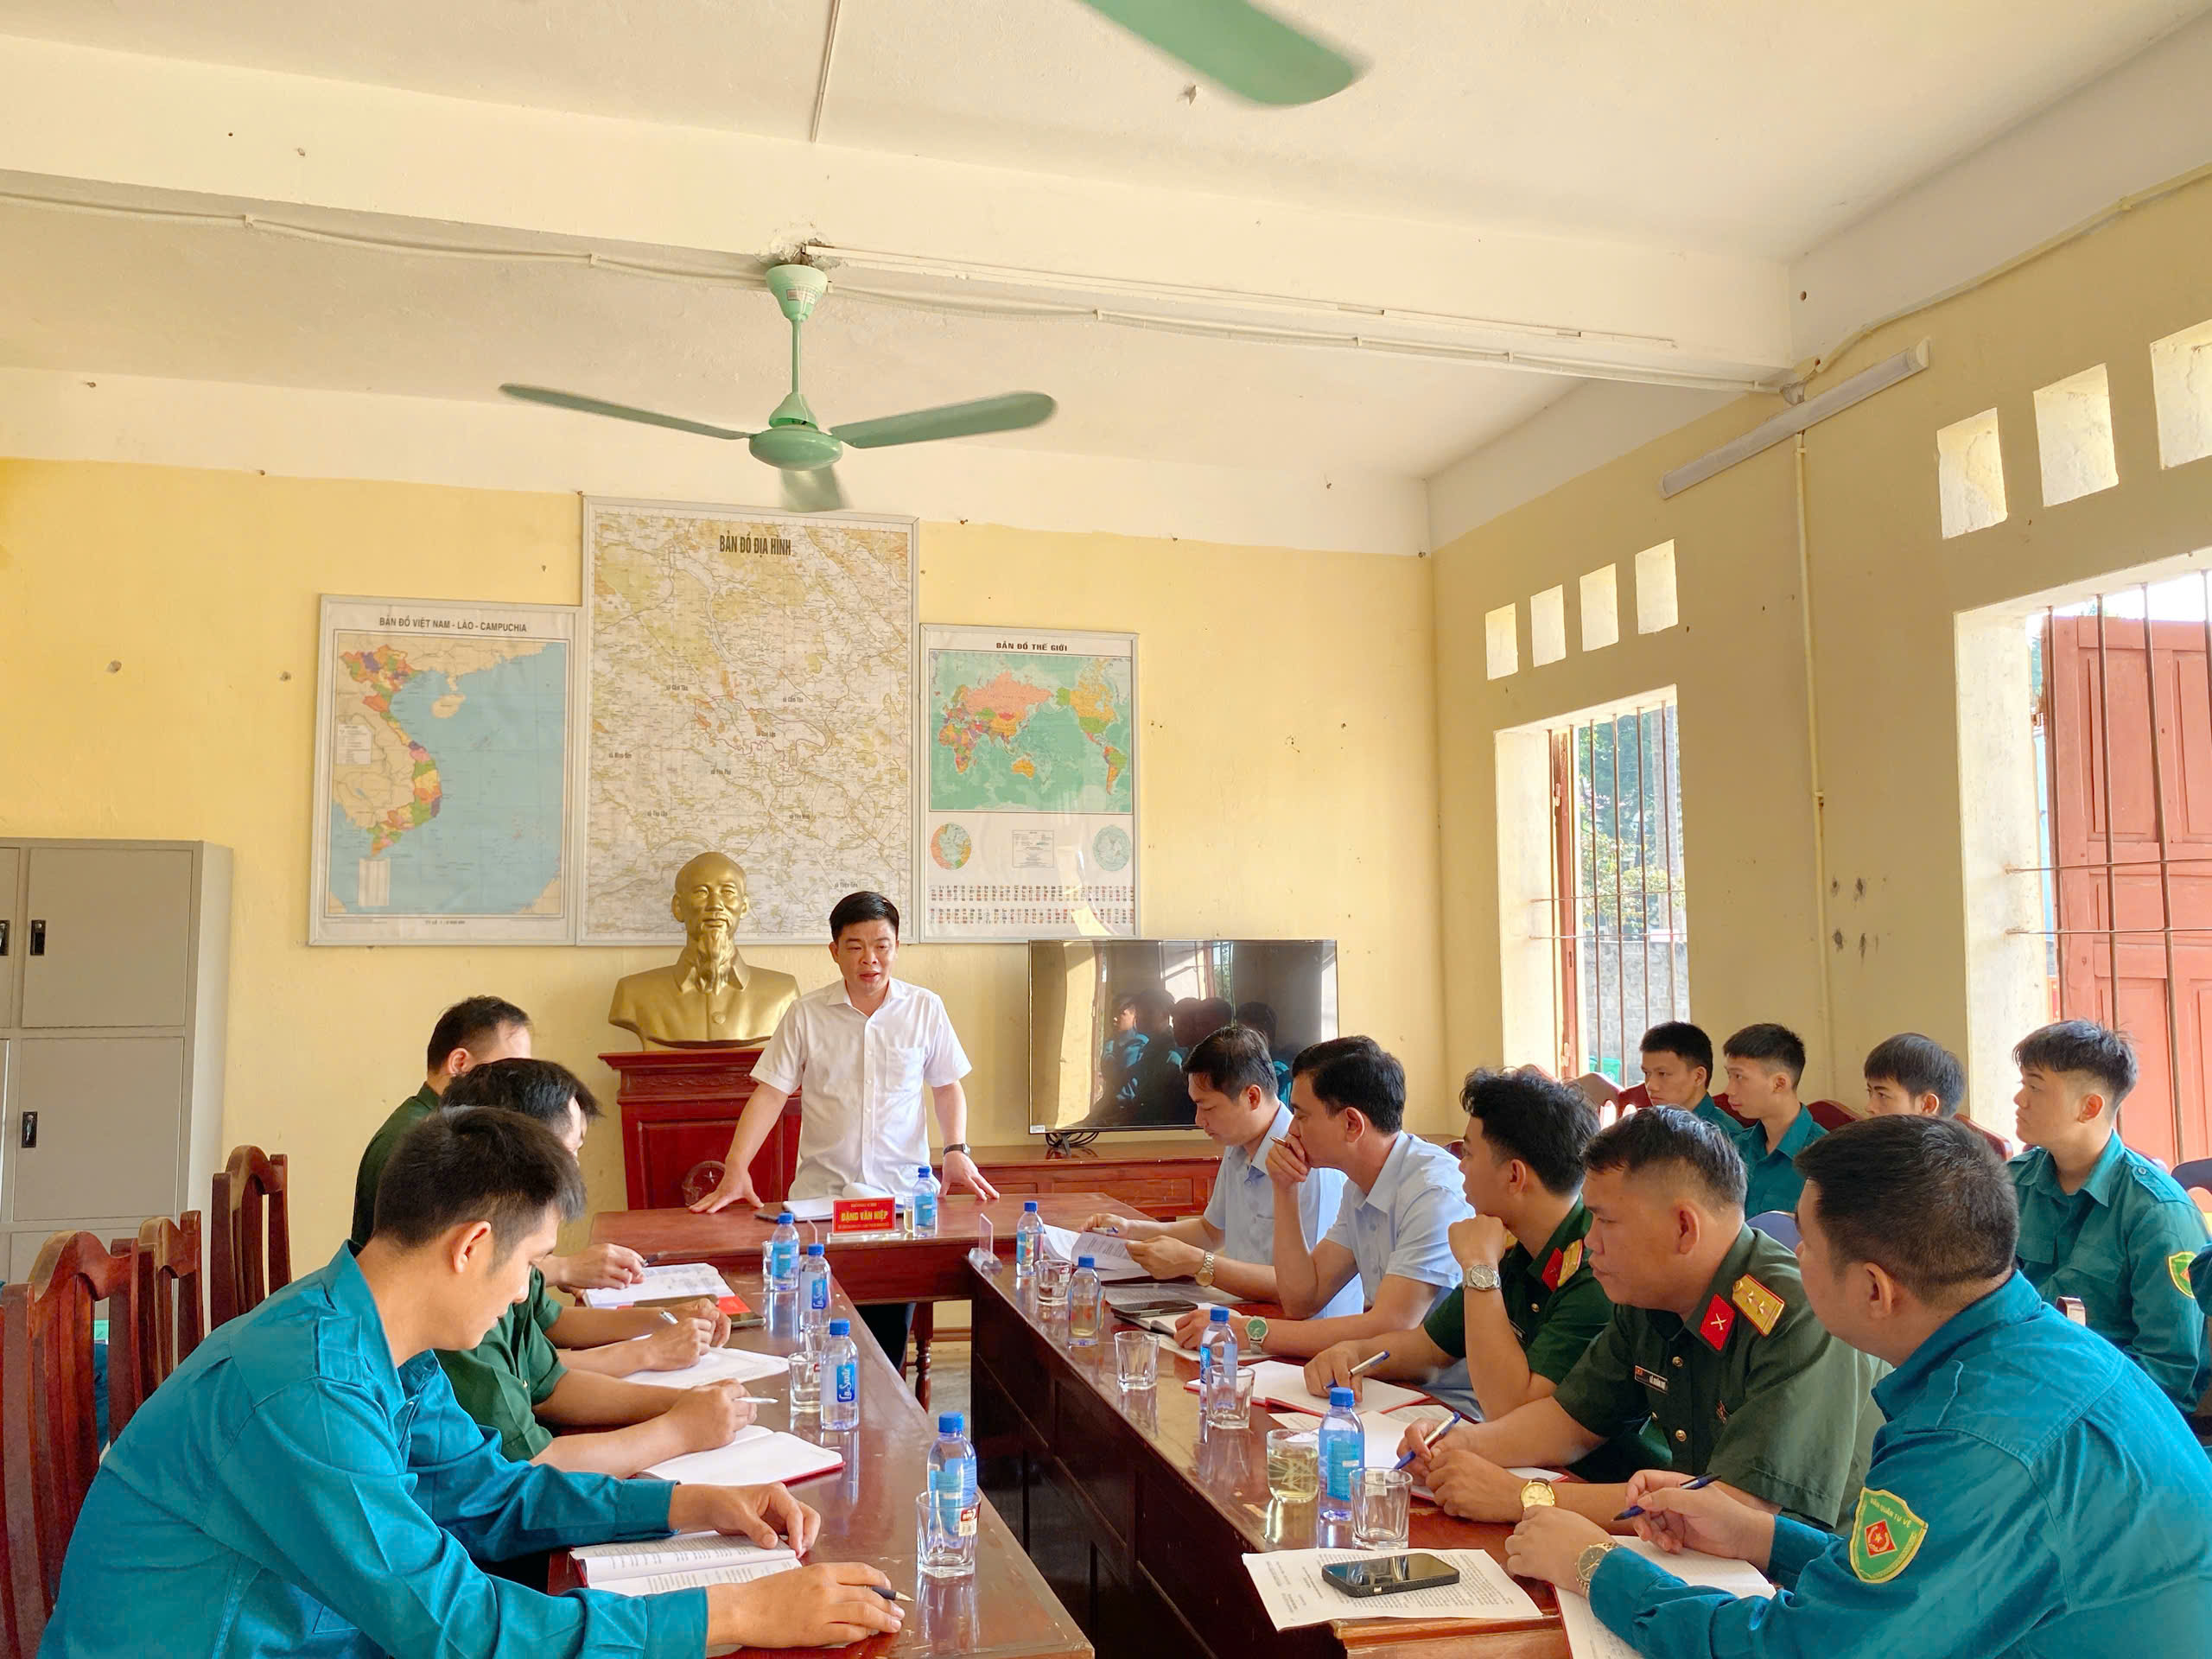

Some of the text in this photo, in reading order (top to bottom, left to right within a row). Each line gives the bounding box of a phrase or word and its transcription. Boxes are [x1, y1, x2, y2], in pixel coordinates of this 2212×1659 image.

[720, 530, 791, 557] BẢN ĐỒ ĐỊA HÌNH
[379, 615, 396, 626] BẢN
[398, 615, 410, 626] ĐỒ
[413, 617, 430, 628] VIỆT
[433, 620, 450, 628] NAM
[480, 621, 527, 632] CAMPUCHIA
[996, 640, 1014, 649] BẢN
